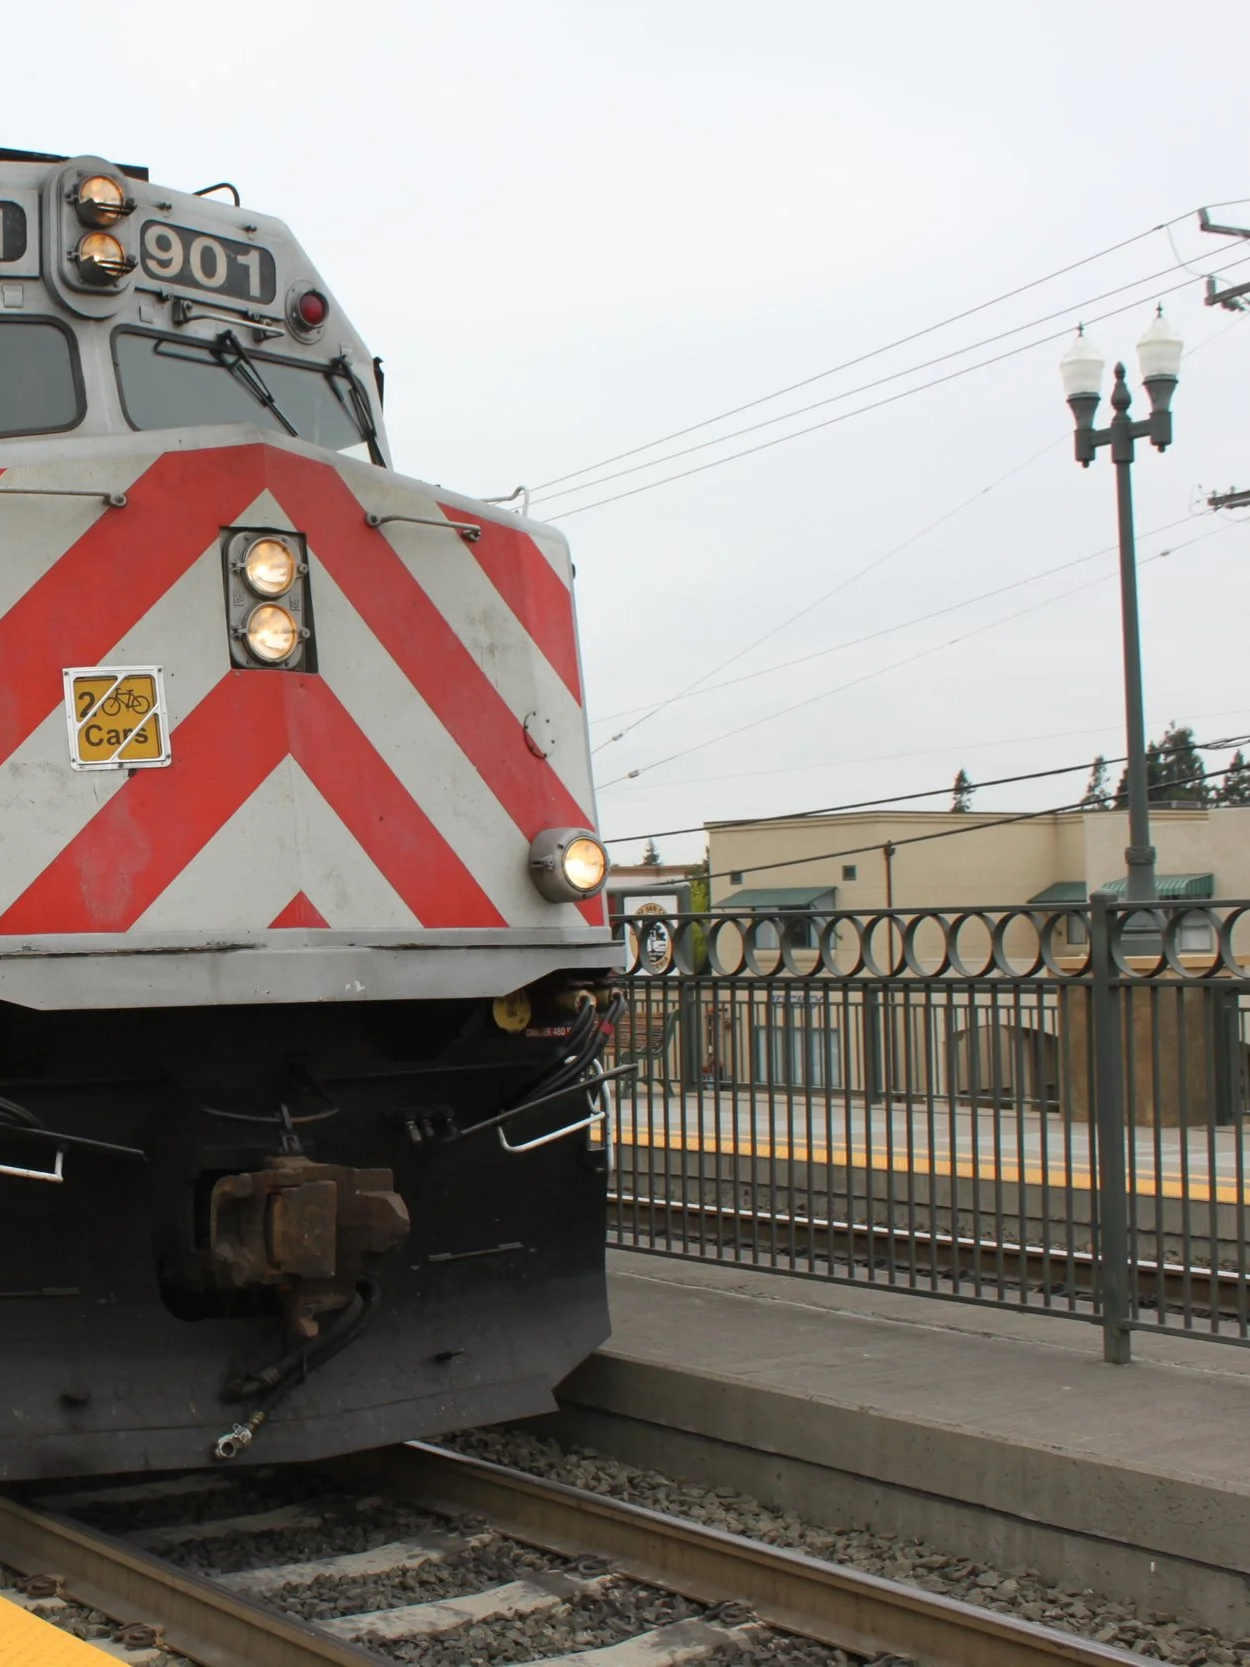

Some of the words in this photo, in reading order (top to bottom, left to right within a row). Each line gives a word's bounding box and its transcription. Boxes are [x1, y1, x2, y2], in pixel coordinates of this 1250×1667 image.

[144, 225, 261, 298] 901
[78, 691, 97, 718] 2
[85, 724, 149, 747] Cars
